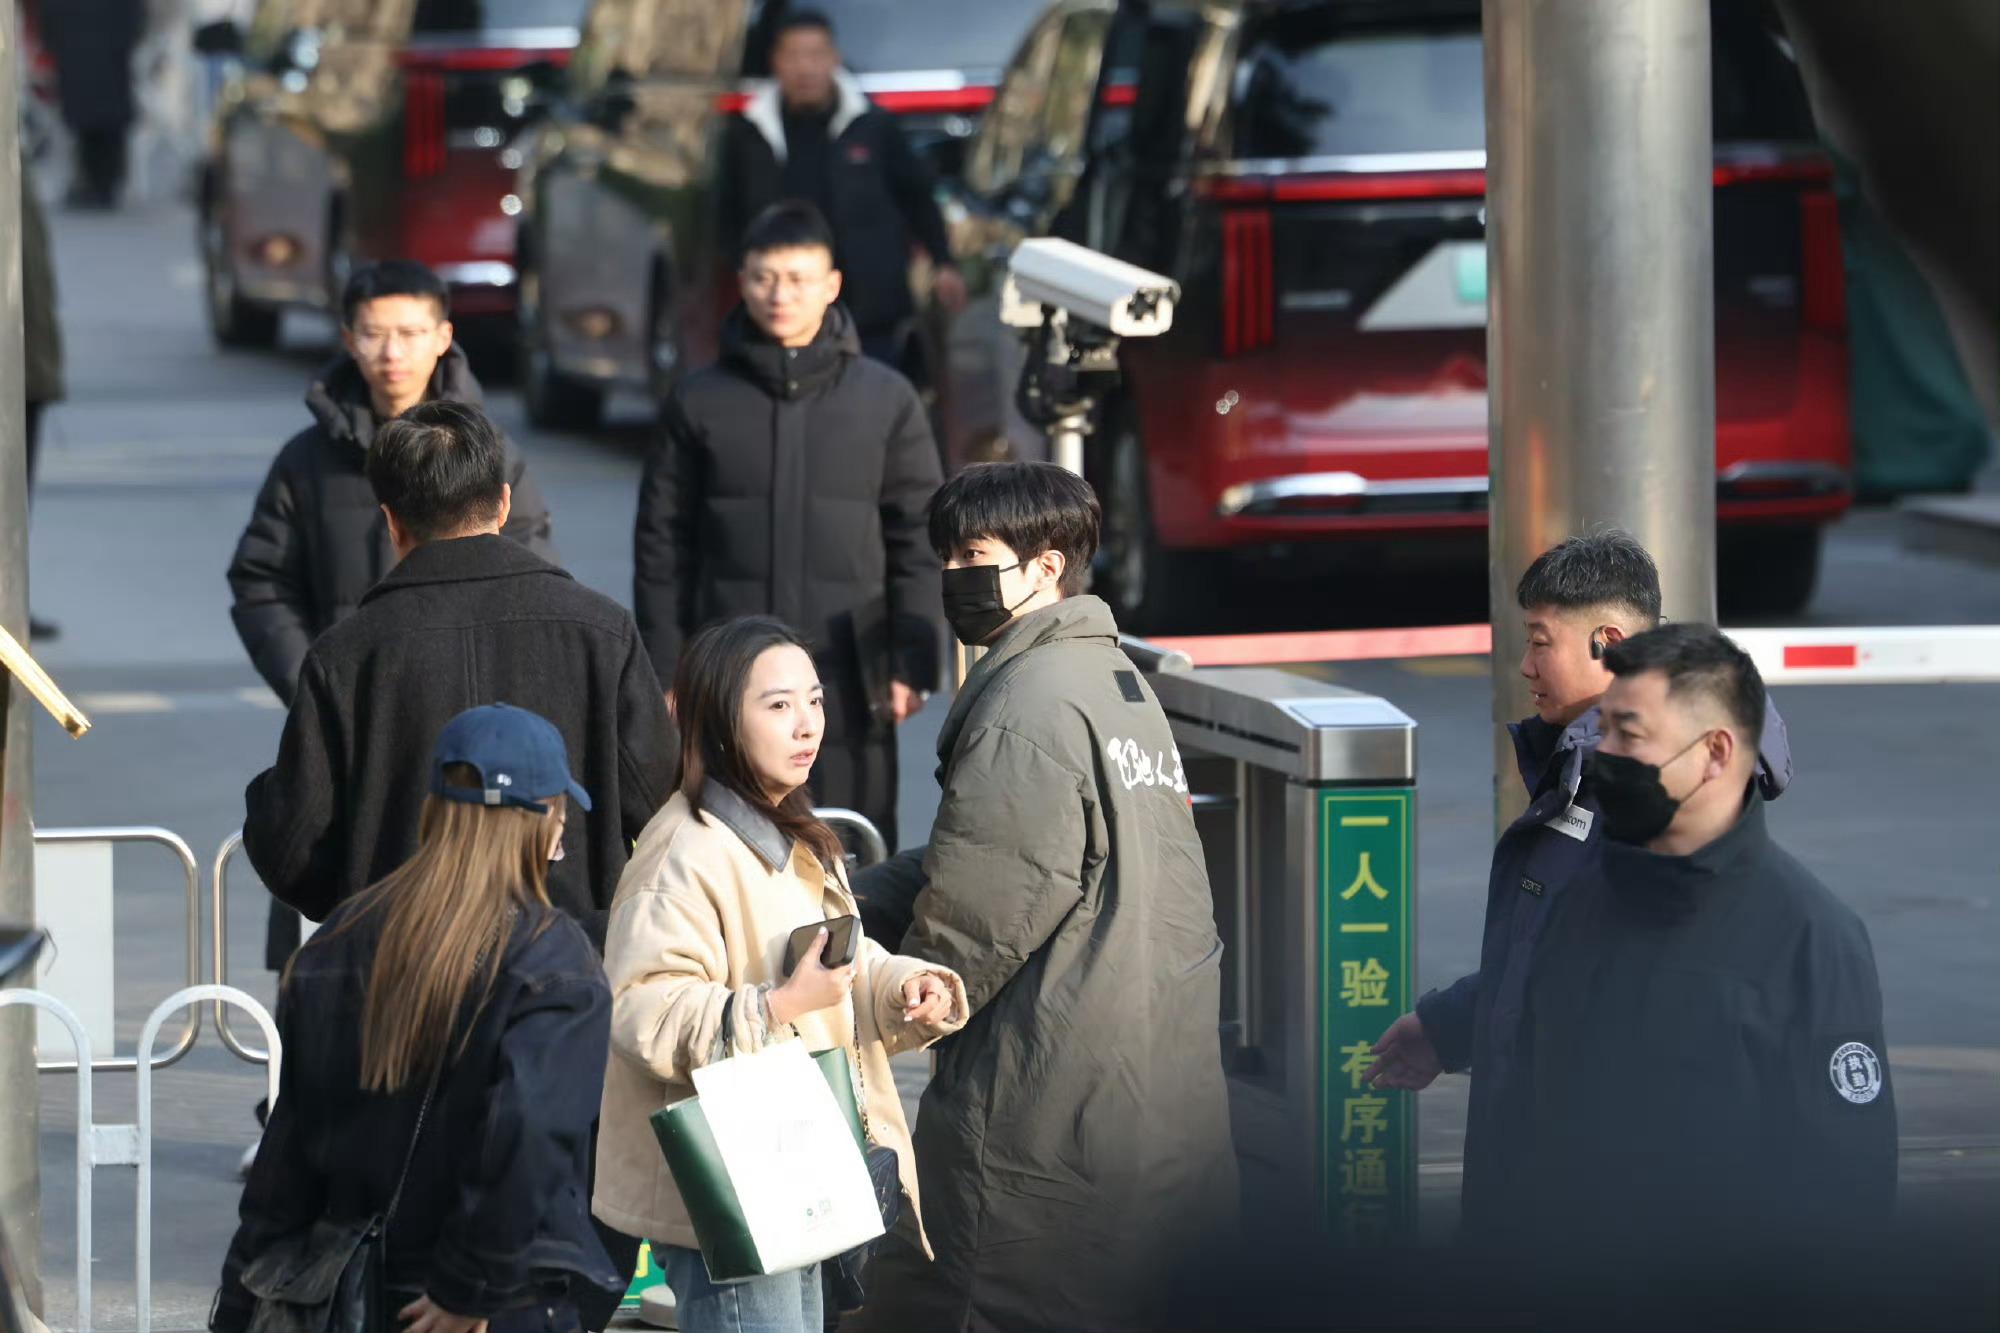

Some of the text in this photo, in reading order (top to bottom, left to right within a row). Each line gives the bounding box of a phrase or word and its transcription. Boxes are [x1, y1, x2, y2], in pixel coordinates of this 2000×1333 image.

[1340, 815, 1389, 1221] 一人一验 有序通
